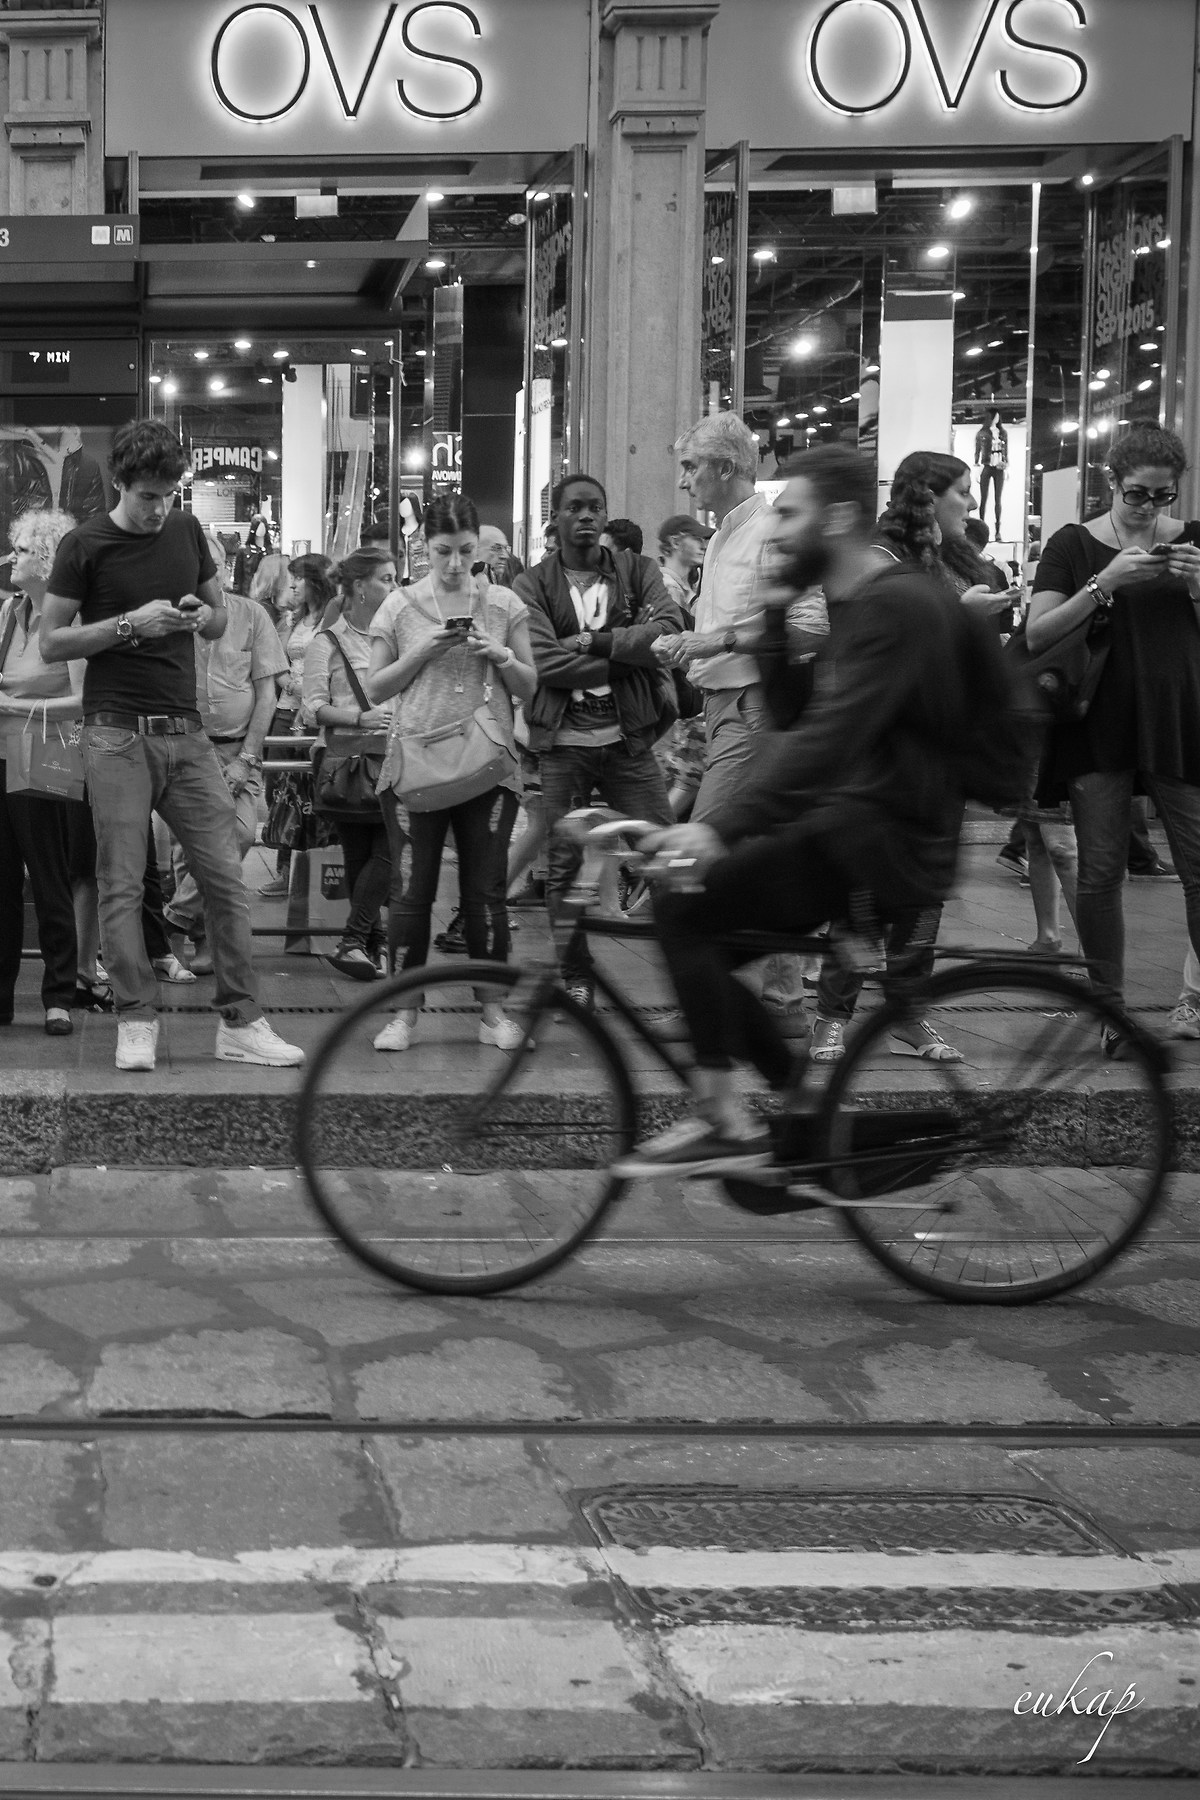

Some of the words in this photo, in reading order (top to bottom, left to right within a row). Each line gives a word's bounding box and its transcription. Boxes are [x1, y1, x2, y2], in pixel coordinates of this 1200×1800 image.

[211, 1, 483, 123] OVS
[806, 0, 1088, 117] OVS
[116, 228, 131, 242] M
[29, 351, 40, 363] 7
[46, 350, 71, 363] MIN
